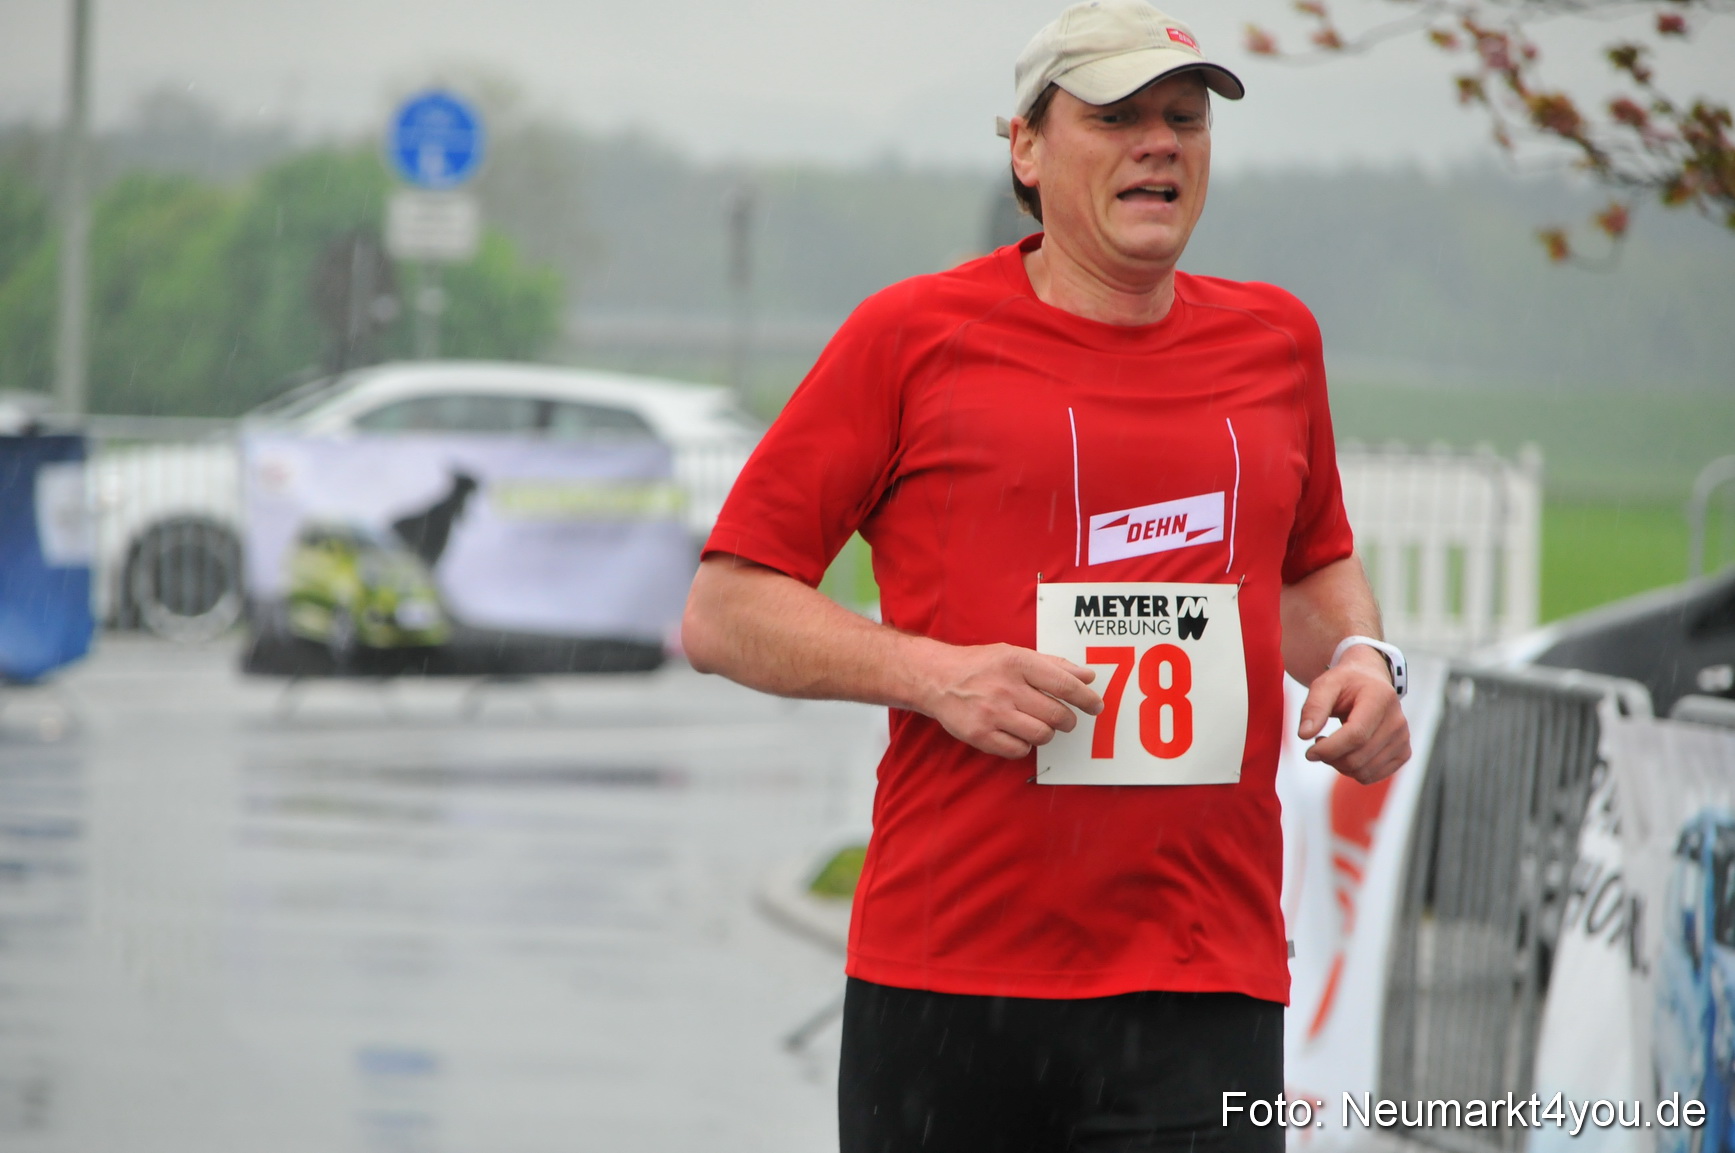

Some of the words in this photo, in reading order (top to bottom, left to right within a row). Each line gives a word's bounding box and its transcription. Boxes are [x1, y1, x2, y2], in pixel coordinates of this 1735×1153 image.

[1126, 513, 1187, 543] DEHN
[1074, 595, 1170, 617] MEYER
[1074, 619, 1171, 635] WERBUNG
[1085, 643, 1193, 759] 78
